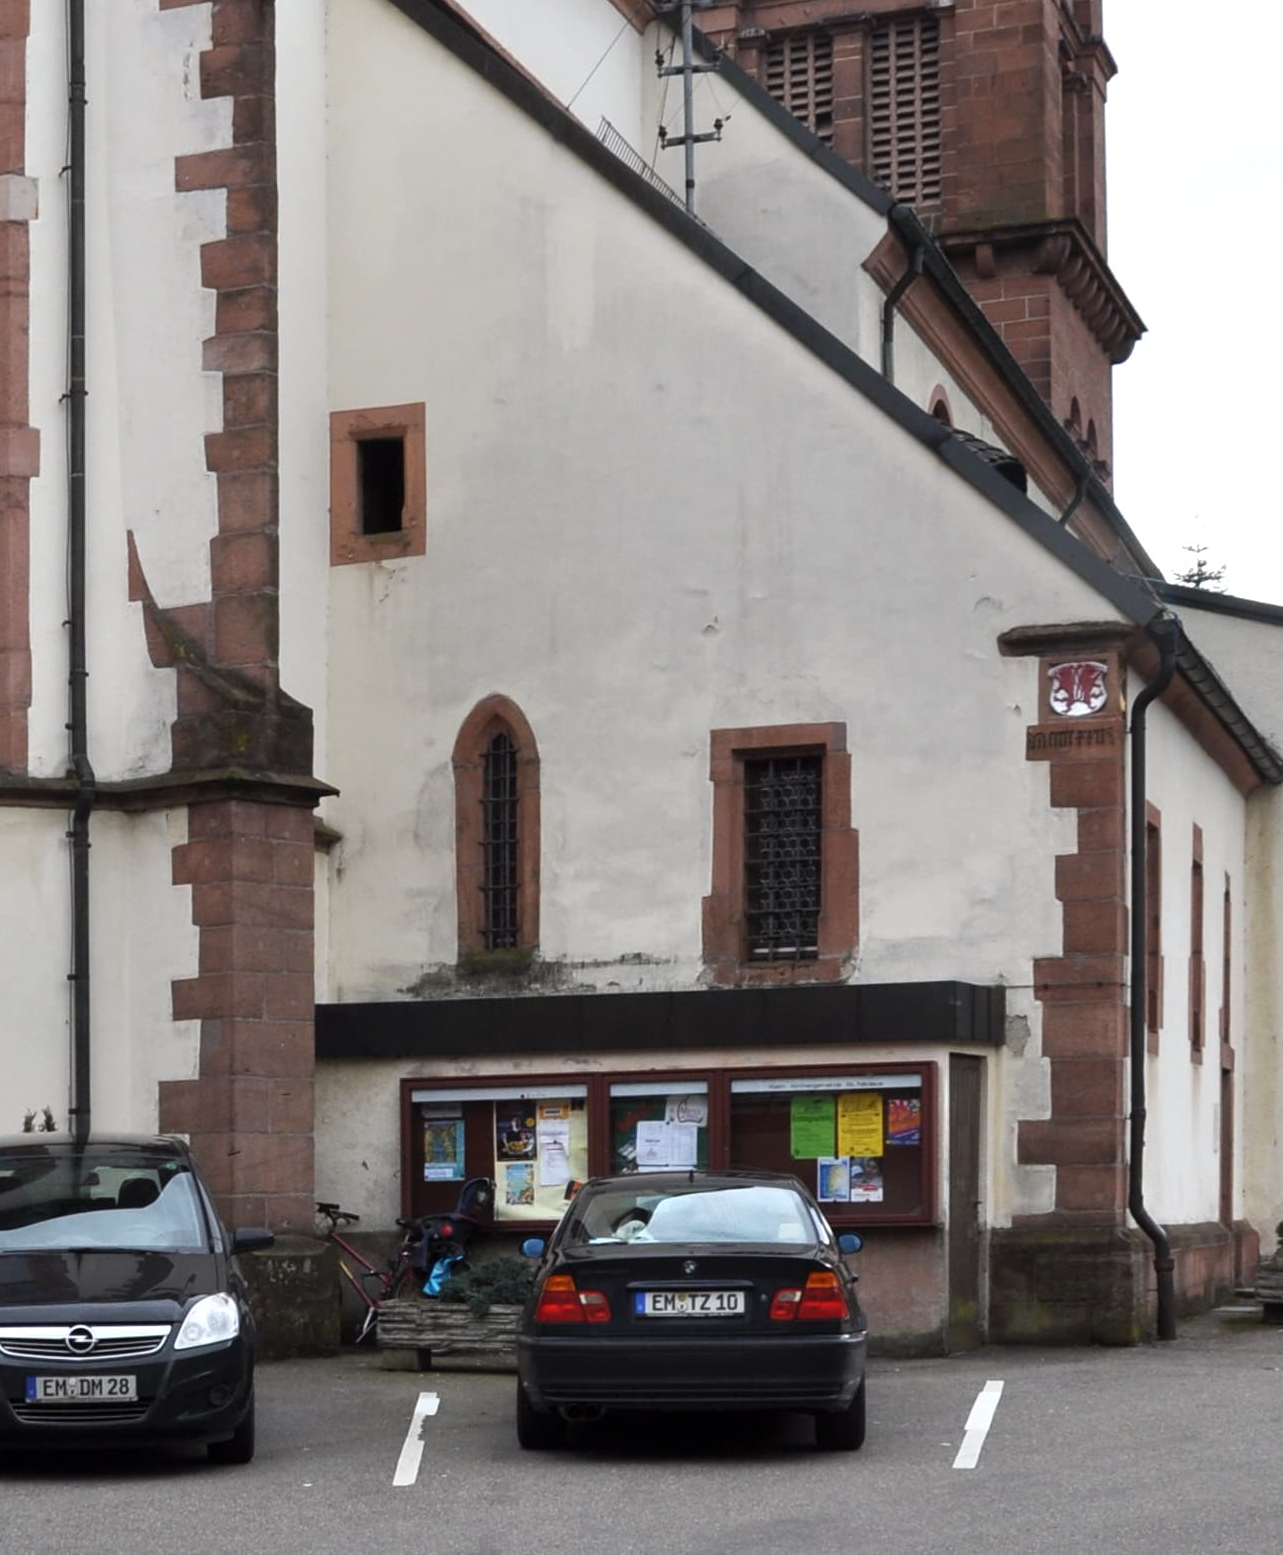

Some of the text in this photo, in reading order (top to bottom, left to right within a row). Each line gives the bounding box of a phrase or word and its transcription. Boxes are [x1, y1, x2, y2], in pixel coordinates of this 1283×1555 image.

[652, 1293, 738, 1311] EM TZ 10
[42, 1377, 130, 1397] EM DM 28
